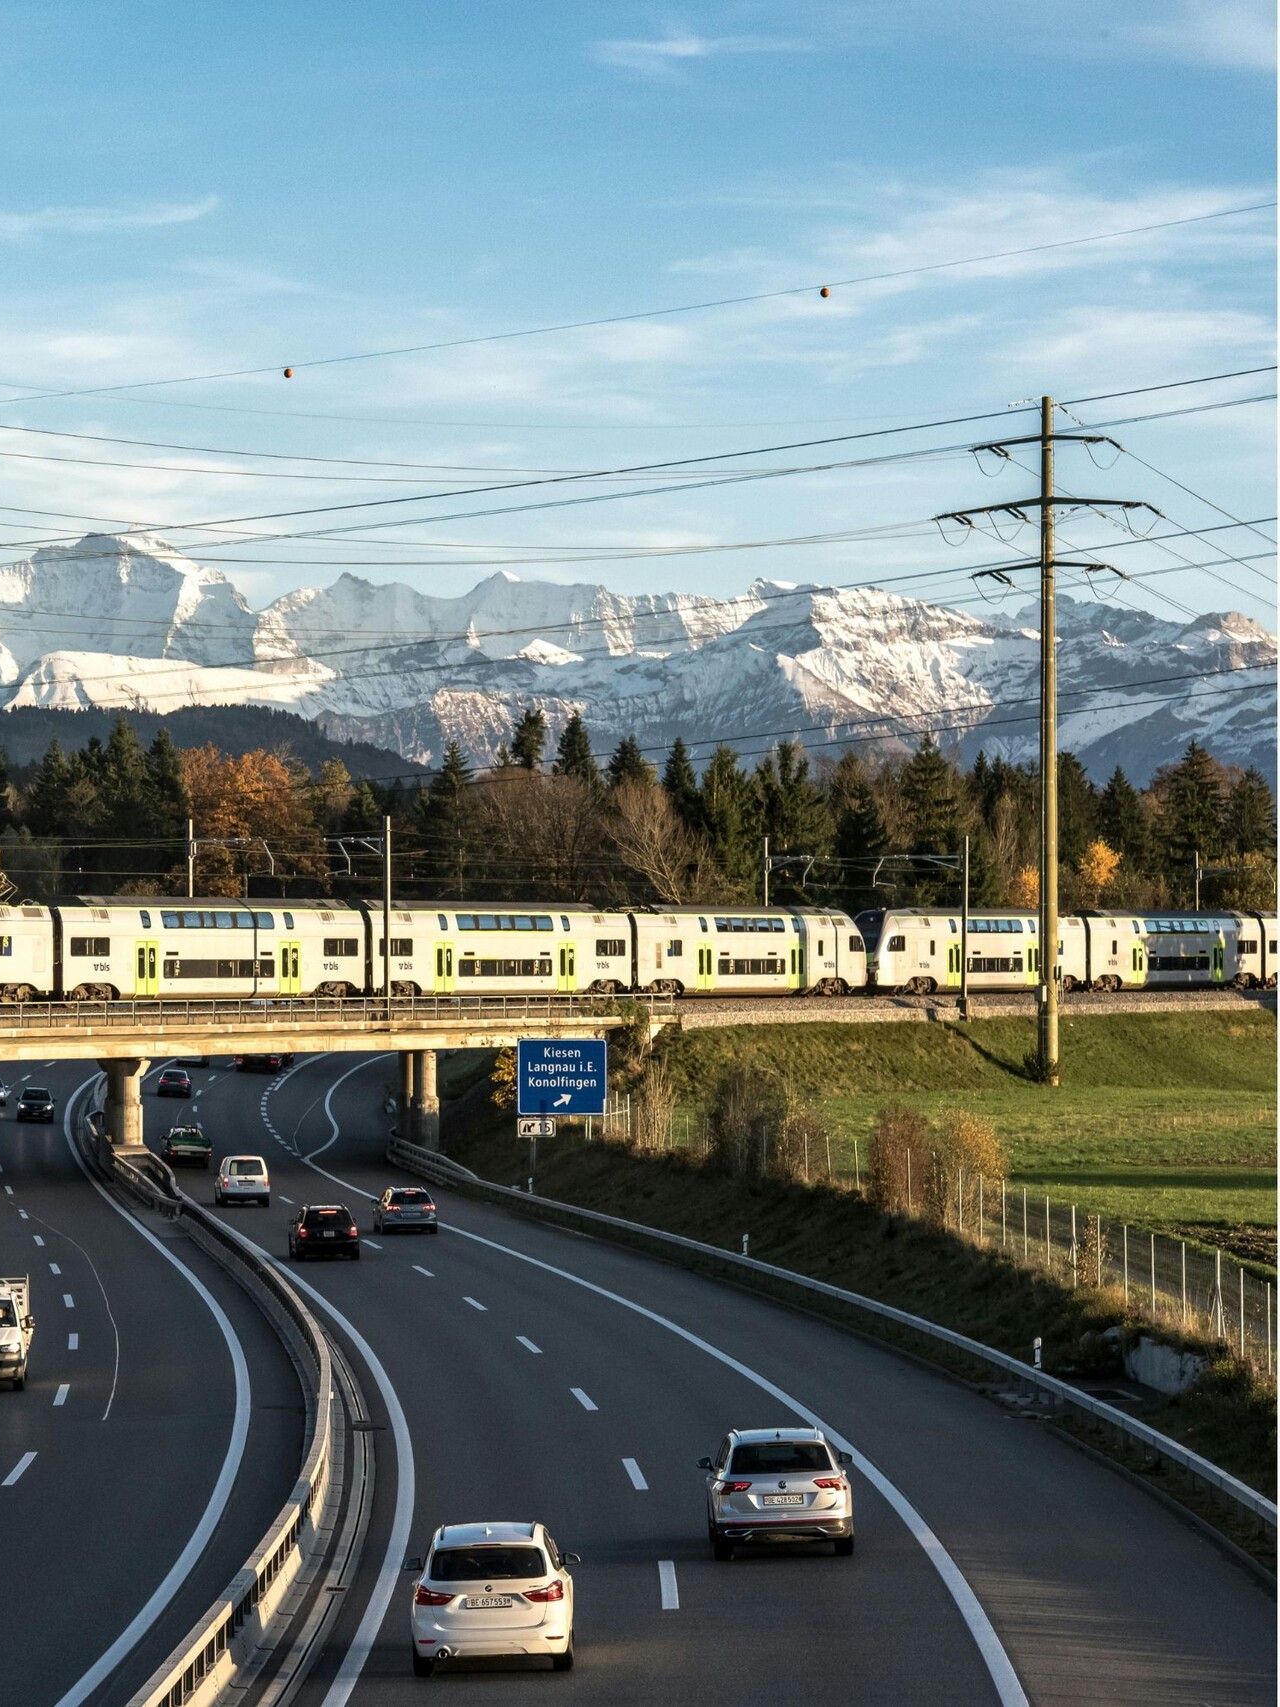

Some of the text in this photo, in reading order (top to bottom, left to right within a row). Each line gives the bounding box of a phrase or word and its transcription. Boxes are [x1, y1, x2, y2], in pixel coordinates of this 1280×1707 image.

[99, 963, 110, 972] bls
[329, 962, 339, 971] bls
[404, 961, 413, 970] bls
[602, 960, 610, 969] bls
[543, 1047, 581, 1058] Kiesen
[527, 1061, 597, 1075] Langnau i.E.
[528, 1076, 597, 1090] Konolfingen
[538, 1123, 551, 1133] 15
[471, 1598, 480, 1606] BE
